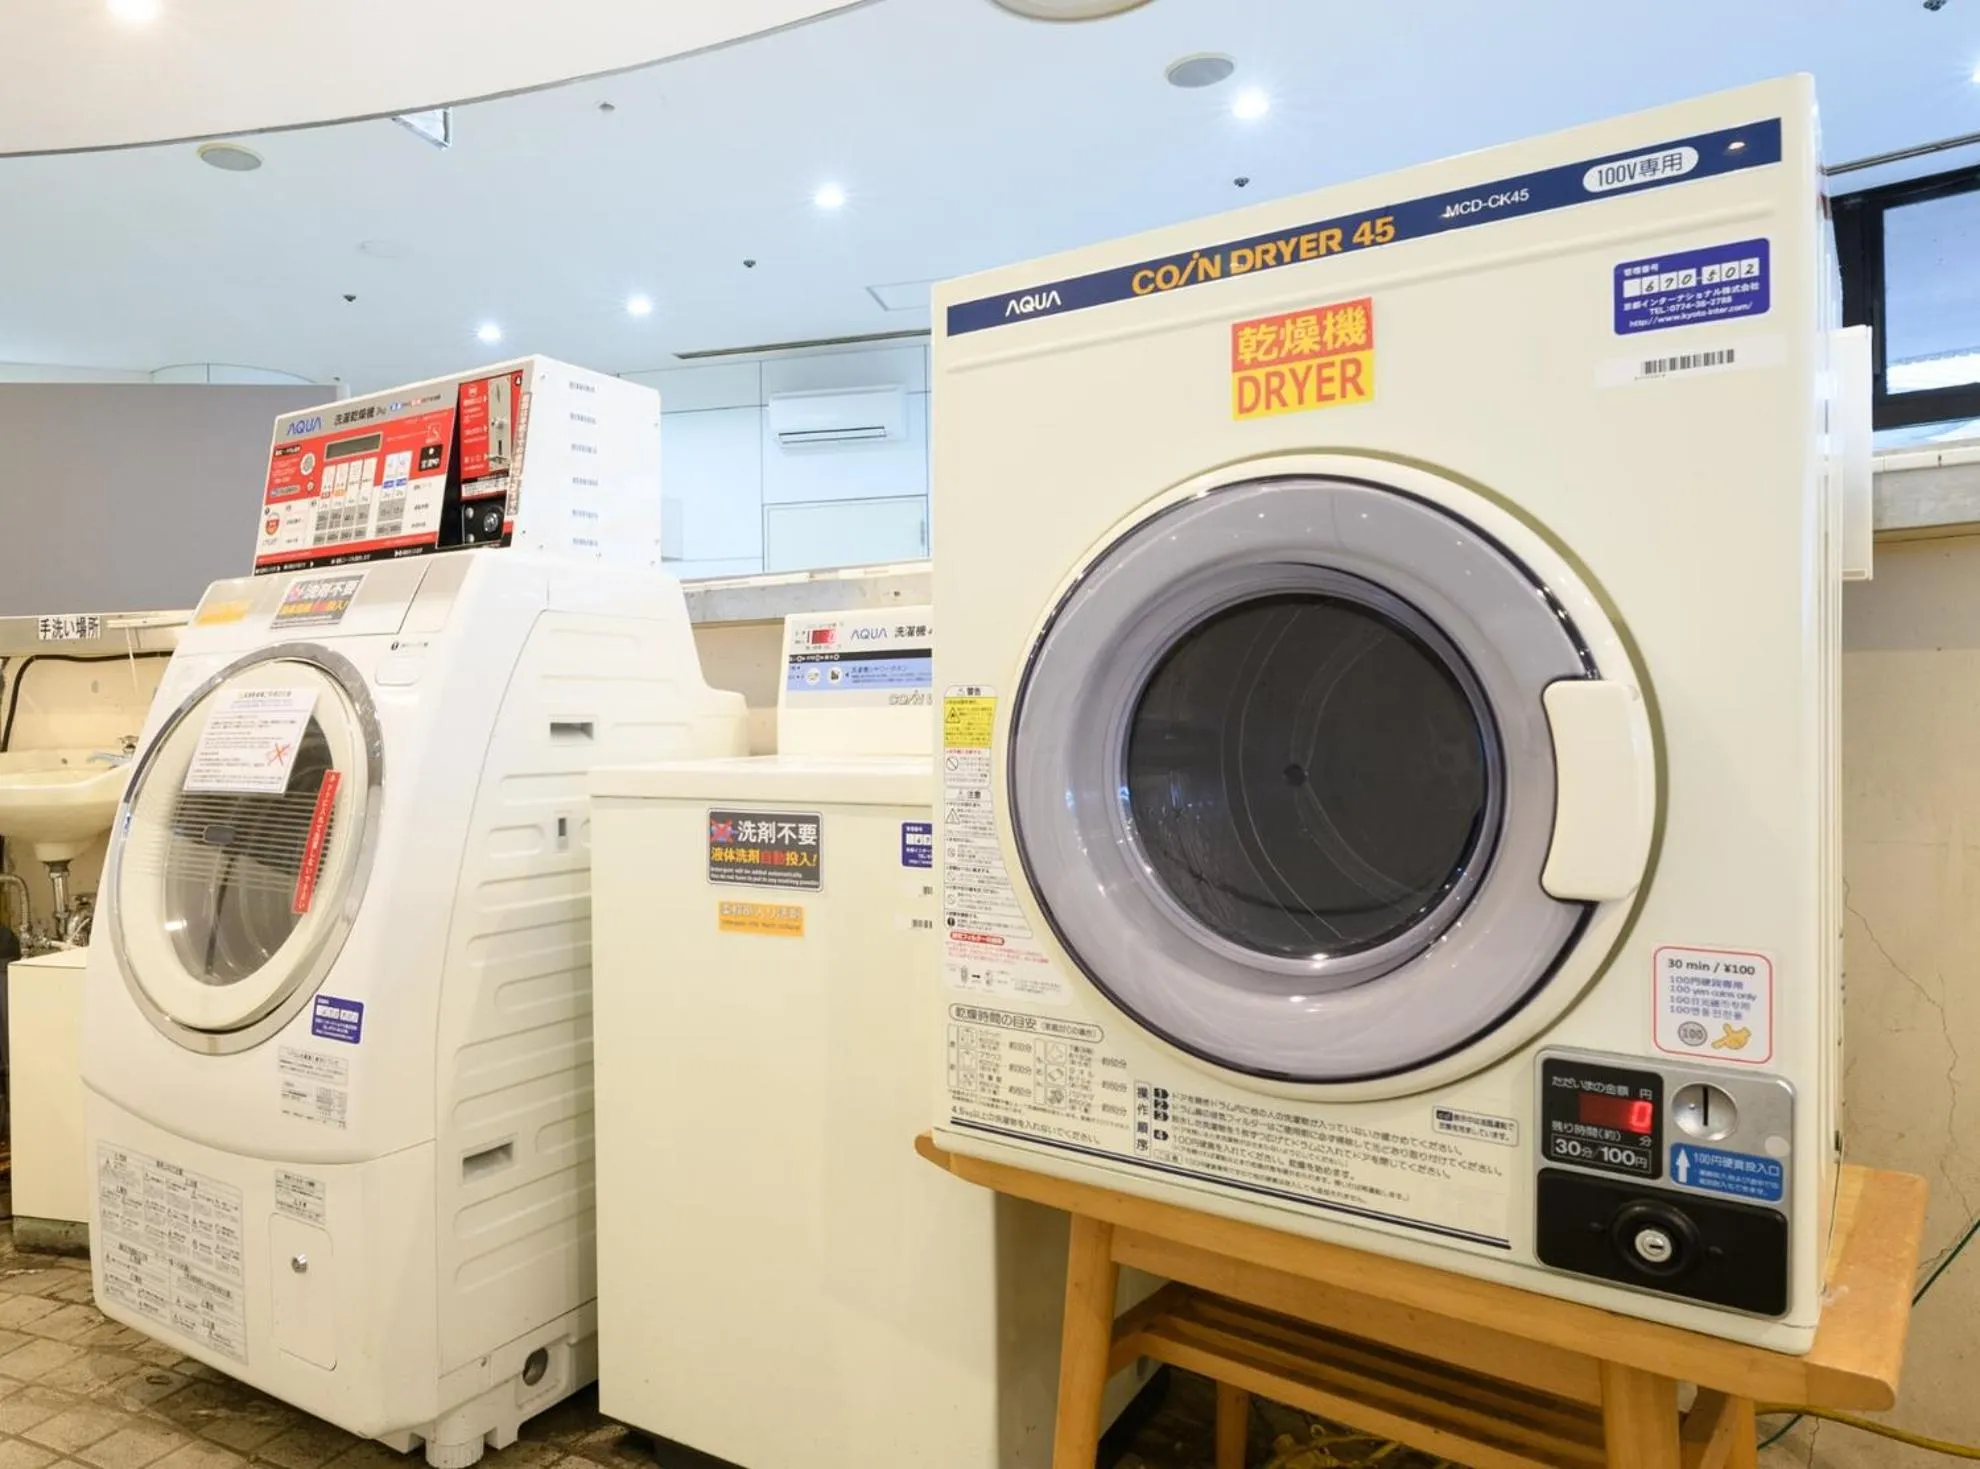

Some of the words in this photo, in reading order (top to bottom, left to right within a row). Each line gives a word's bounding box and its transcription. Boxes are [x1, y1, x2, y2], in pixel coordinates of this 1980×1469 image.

[1597, 151, 1684, 188] 100V専用
[1445, 187, 1530, 218] MCD-CK45
[1229, 226, 1342, 275] DRYER
[1352, 215, 1396, 248] 45
[1004, 289, 1062, 317] AQUA
[1236, 304, 1367, 366] 乾燥機
[1237, 356, 1366, 416] DRYER
[287, 416, 322, 436] AQUA
[40, 617, 99, 639] 手洗い場所
[850, 627, 888, 641] AQUA
[894, 625, 927, 638] 洗濯機
[737, 819, 818, 846] 洗剤不要
[1668, 958, 1683, 969] 30
[1686, 961, 1710, 971] min
[1724, 963, 1756, 976] ¥100
[1669, 985, 1690, 994] 100
[1737, 992, 1757, 1002] only
[1551, 1075, 1630, 1097] ただいまの金額
[1639, 1088, 1653, 1100] 円
[1631, 1100, 1654, 1129] 0
[1551, 1120, 1622, 1142] 残り時間(約)
[1693, 1151, 1781, 1177] 100円硬貨投入口
